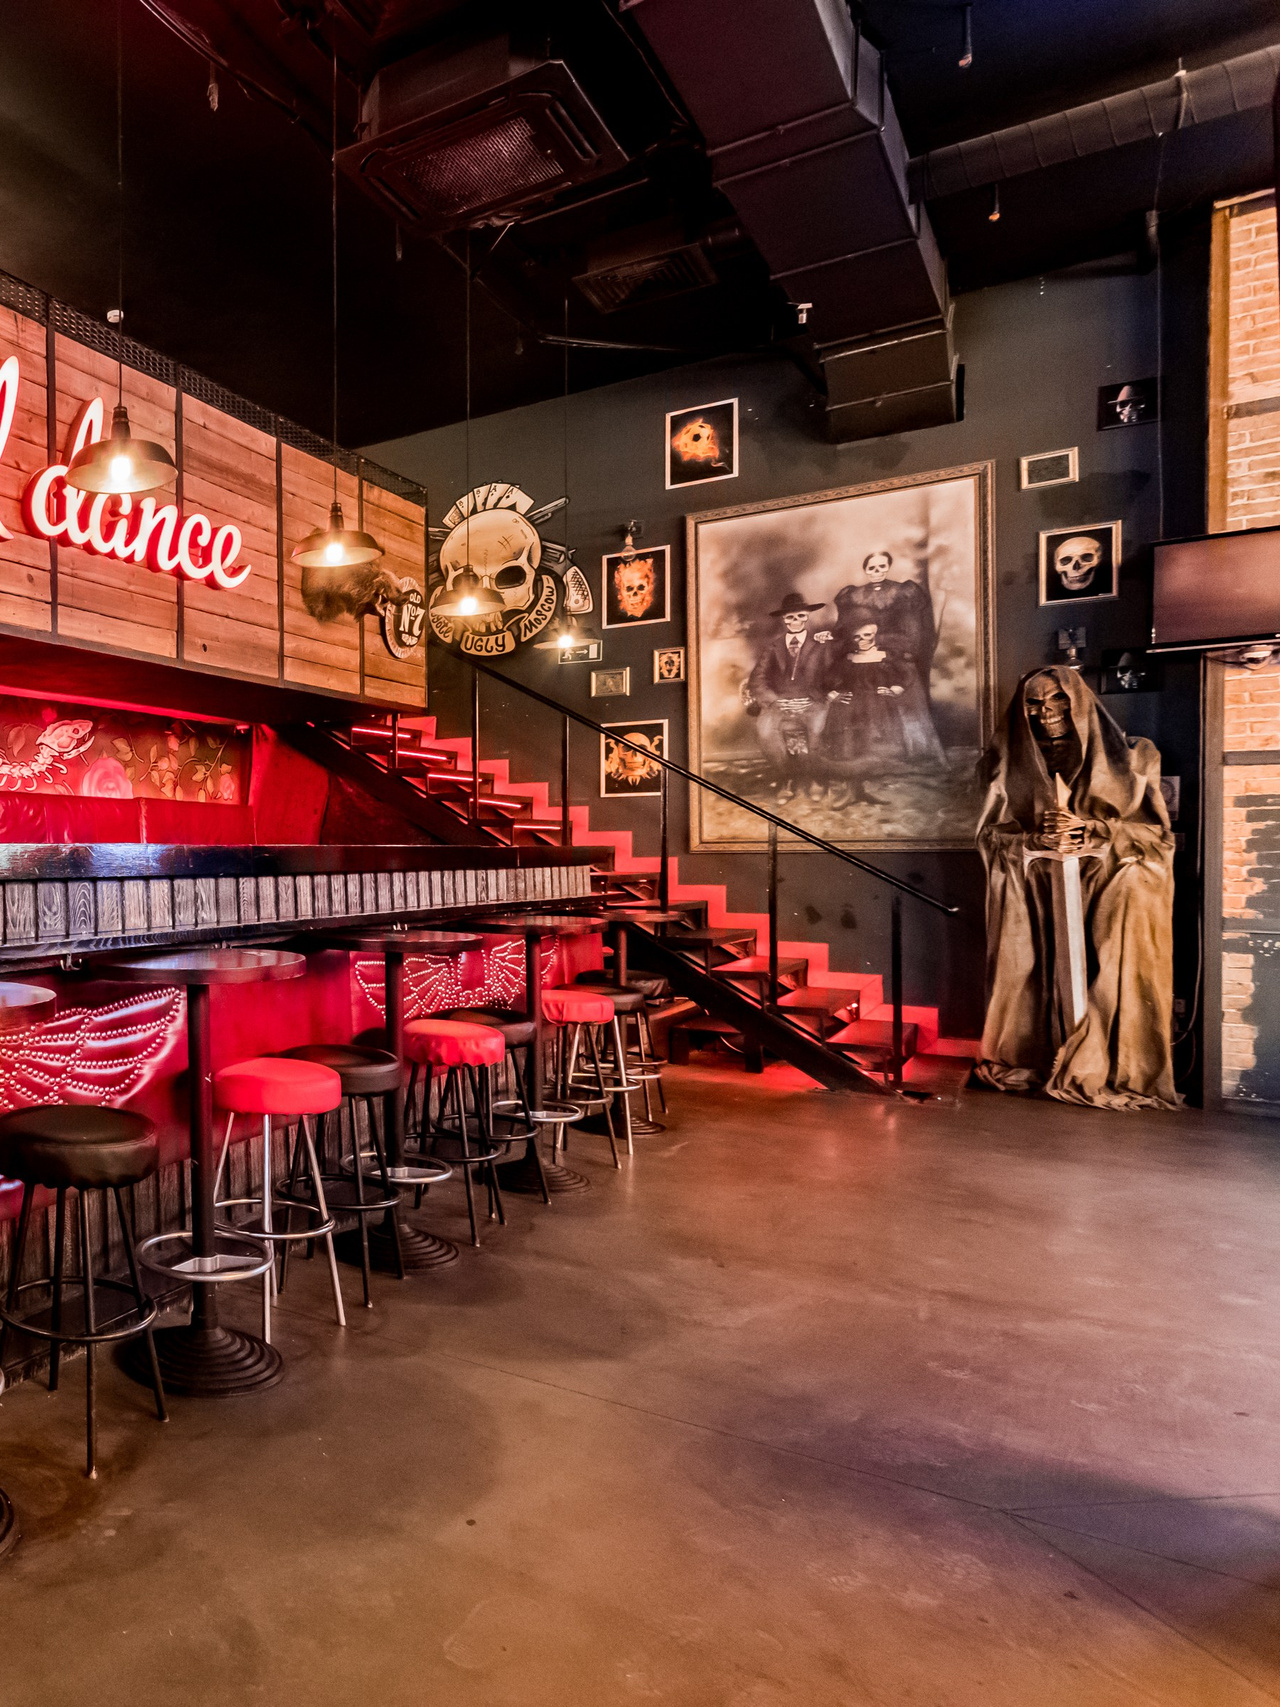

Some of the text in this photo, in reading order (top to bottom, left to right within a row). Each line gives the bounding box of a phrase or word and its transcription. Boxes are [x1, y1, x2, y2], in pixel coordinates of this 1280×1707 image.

[22, 397, 251, 588] dance
[409, 592, 422, 604] OLD
[430, 613, 454, 638] yote
[464, 635, 506, 653] UGLY
